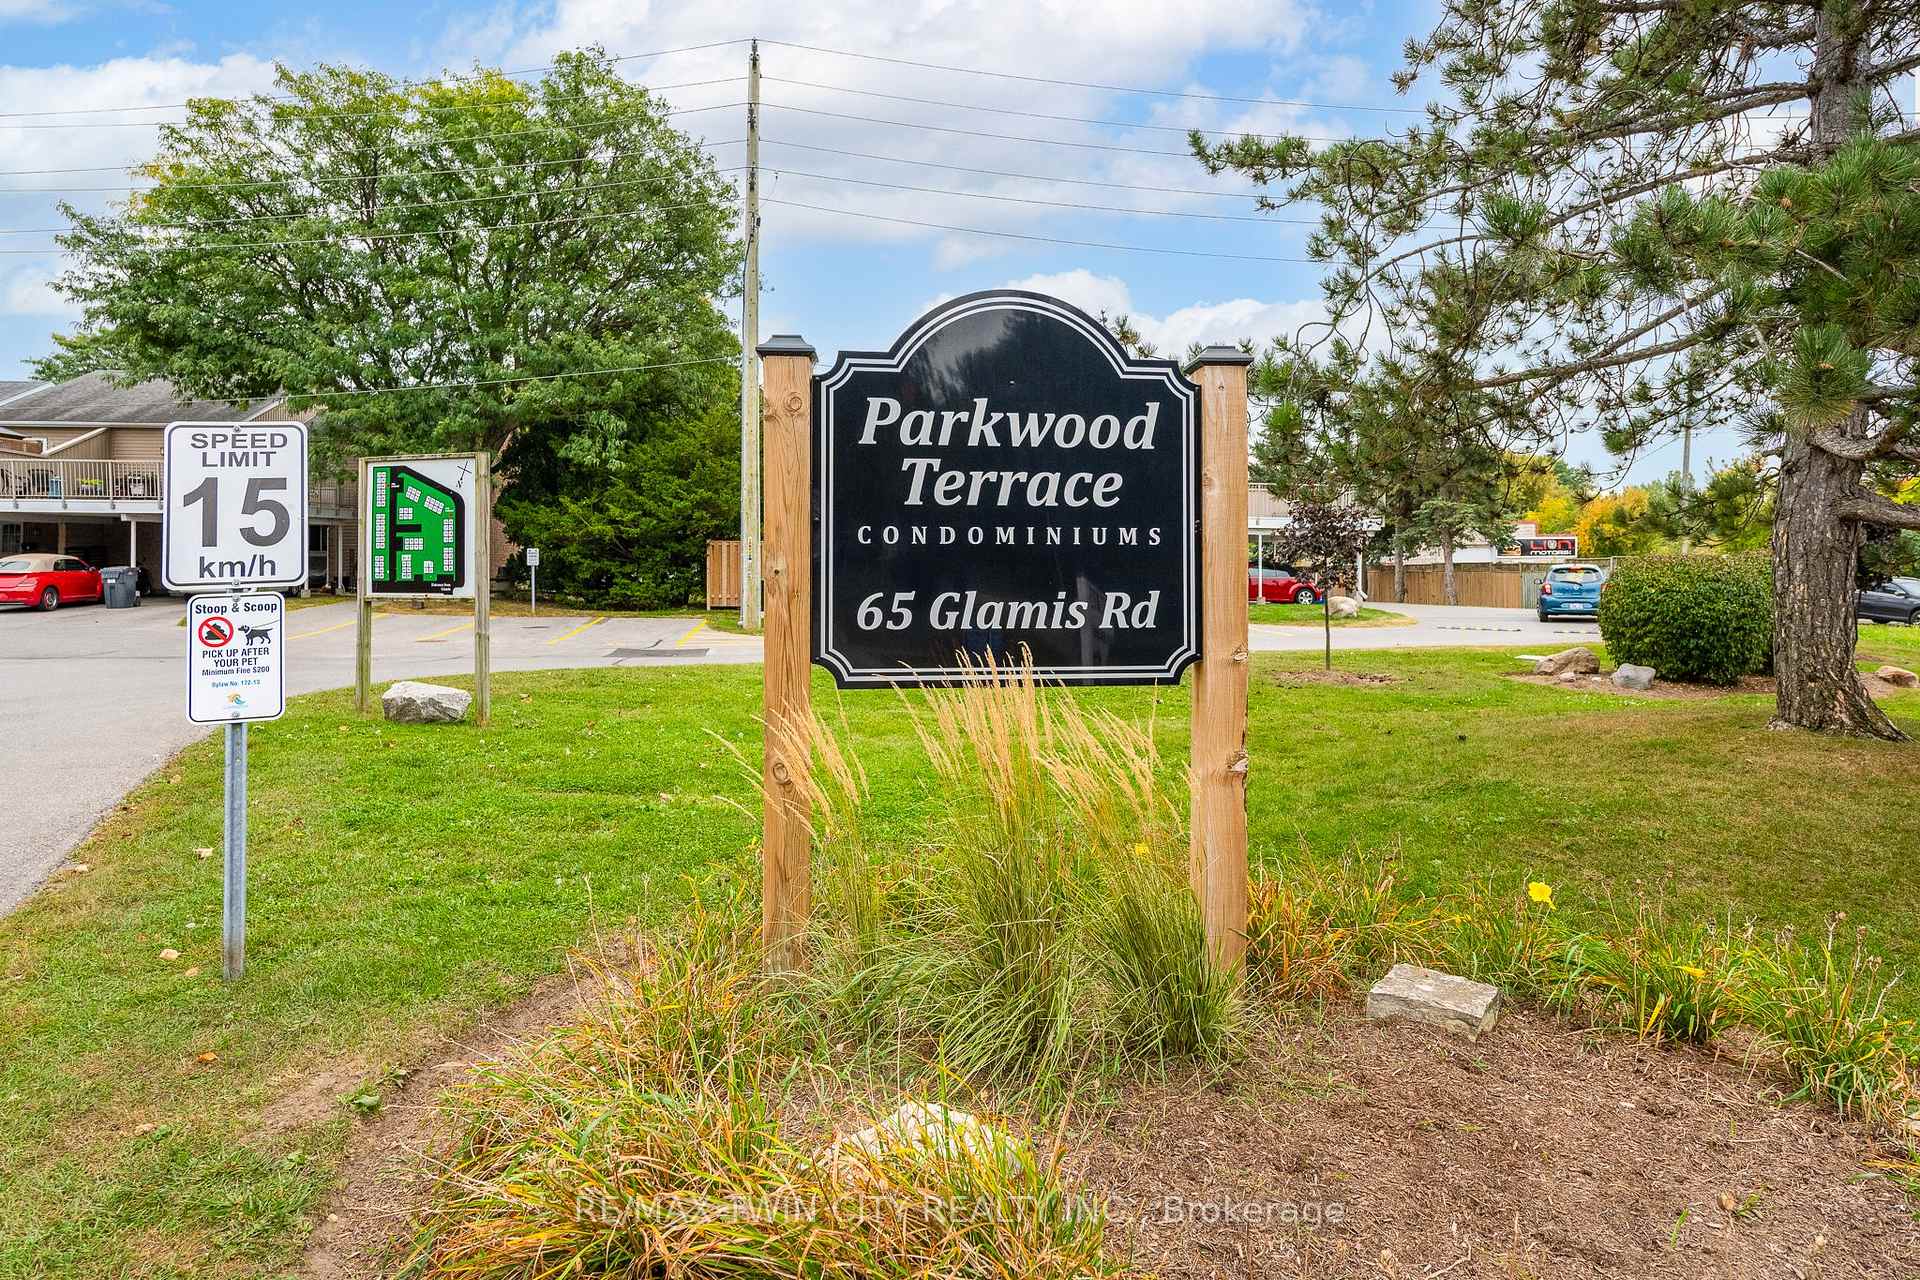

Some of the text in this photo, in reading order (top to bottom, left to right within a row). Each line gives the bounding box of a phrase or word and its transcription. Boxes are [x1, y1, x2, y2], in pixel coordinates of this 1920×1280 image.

[858, 396, 1160, 450] Parkwood
[190, 433, 288, 449] SPEED
[201, 451, 277, 468] LIMIT
[901, 457, 1123, 507] Terrace
[183, 476, 291, 548] 15
[857, 525, 1161, 545] CONDOMINIUMS
[199, 554, 276, 579] km/h
[195, 602, 278, 616] Stoop & Scoop
[856, 590, 1161, 631] 65 Glamis Rd
[202, 647, 270, 659] PICK UP AFTER
[201, 666, 270, 677] Minimum Fine $200
[214, 657, 258, 668] YOUR PET
